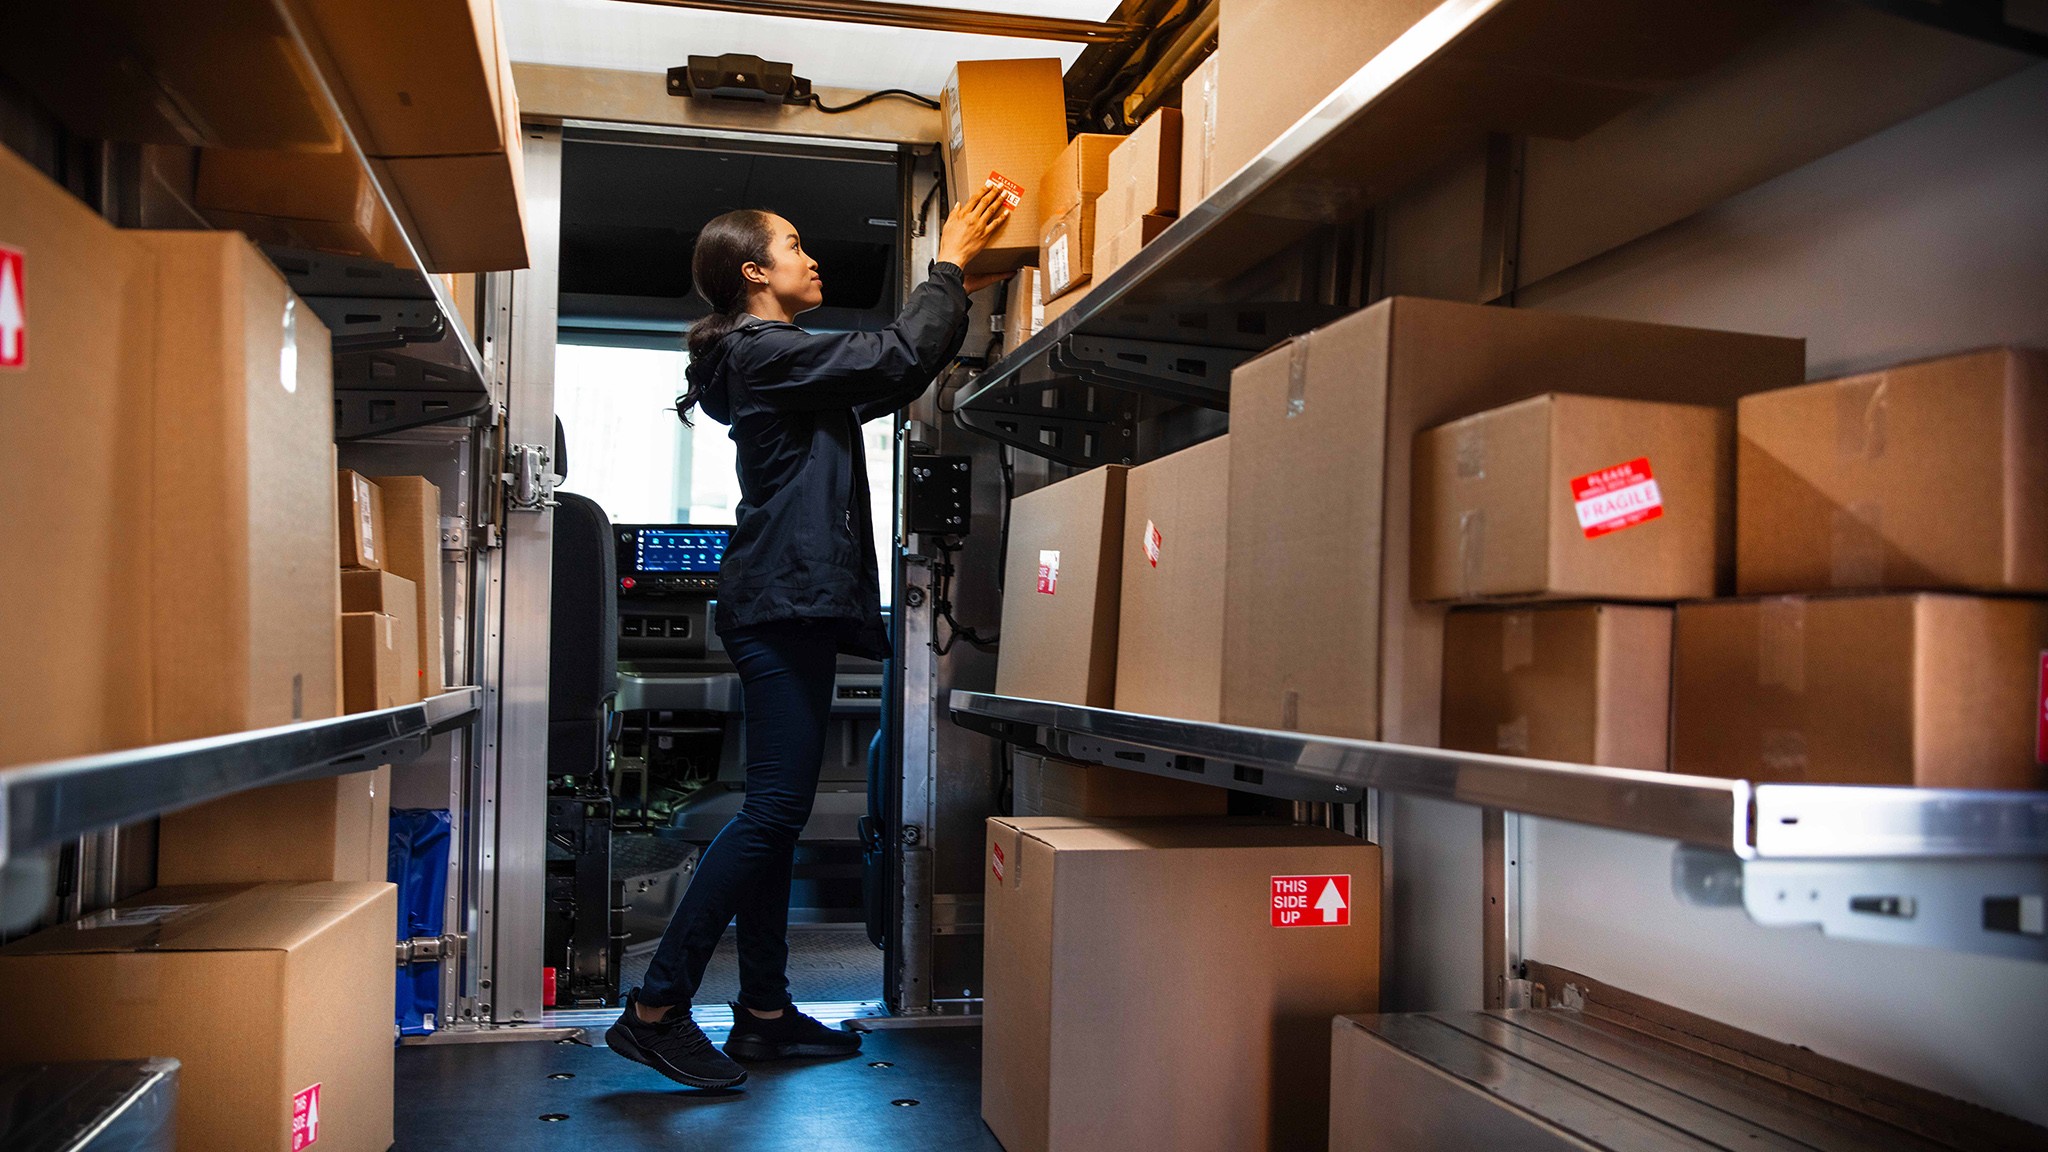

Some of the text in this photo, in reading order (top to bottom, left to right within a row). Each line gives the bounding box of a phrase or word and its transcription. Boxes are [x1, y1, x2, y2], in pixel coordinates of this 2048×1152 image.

[998, 176, 1017, 190] PLEASE
[1587, 464, 1633, 486] PLEASE
[1582, 486, 1655, 521] FRAGILE
[1274, 880, 1308, 893] THIS
[1274, 895, 1308, 909] SIDE
[1280, 911, 1301, 924] UP
[294, 1095, 307, 1114] THIS
[293, 1113, 306, 1133] SIDE
[294, 1133, 303, 1150] UP
